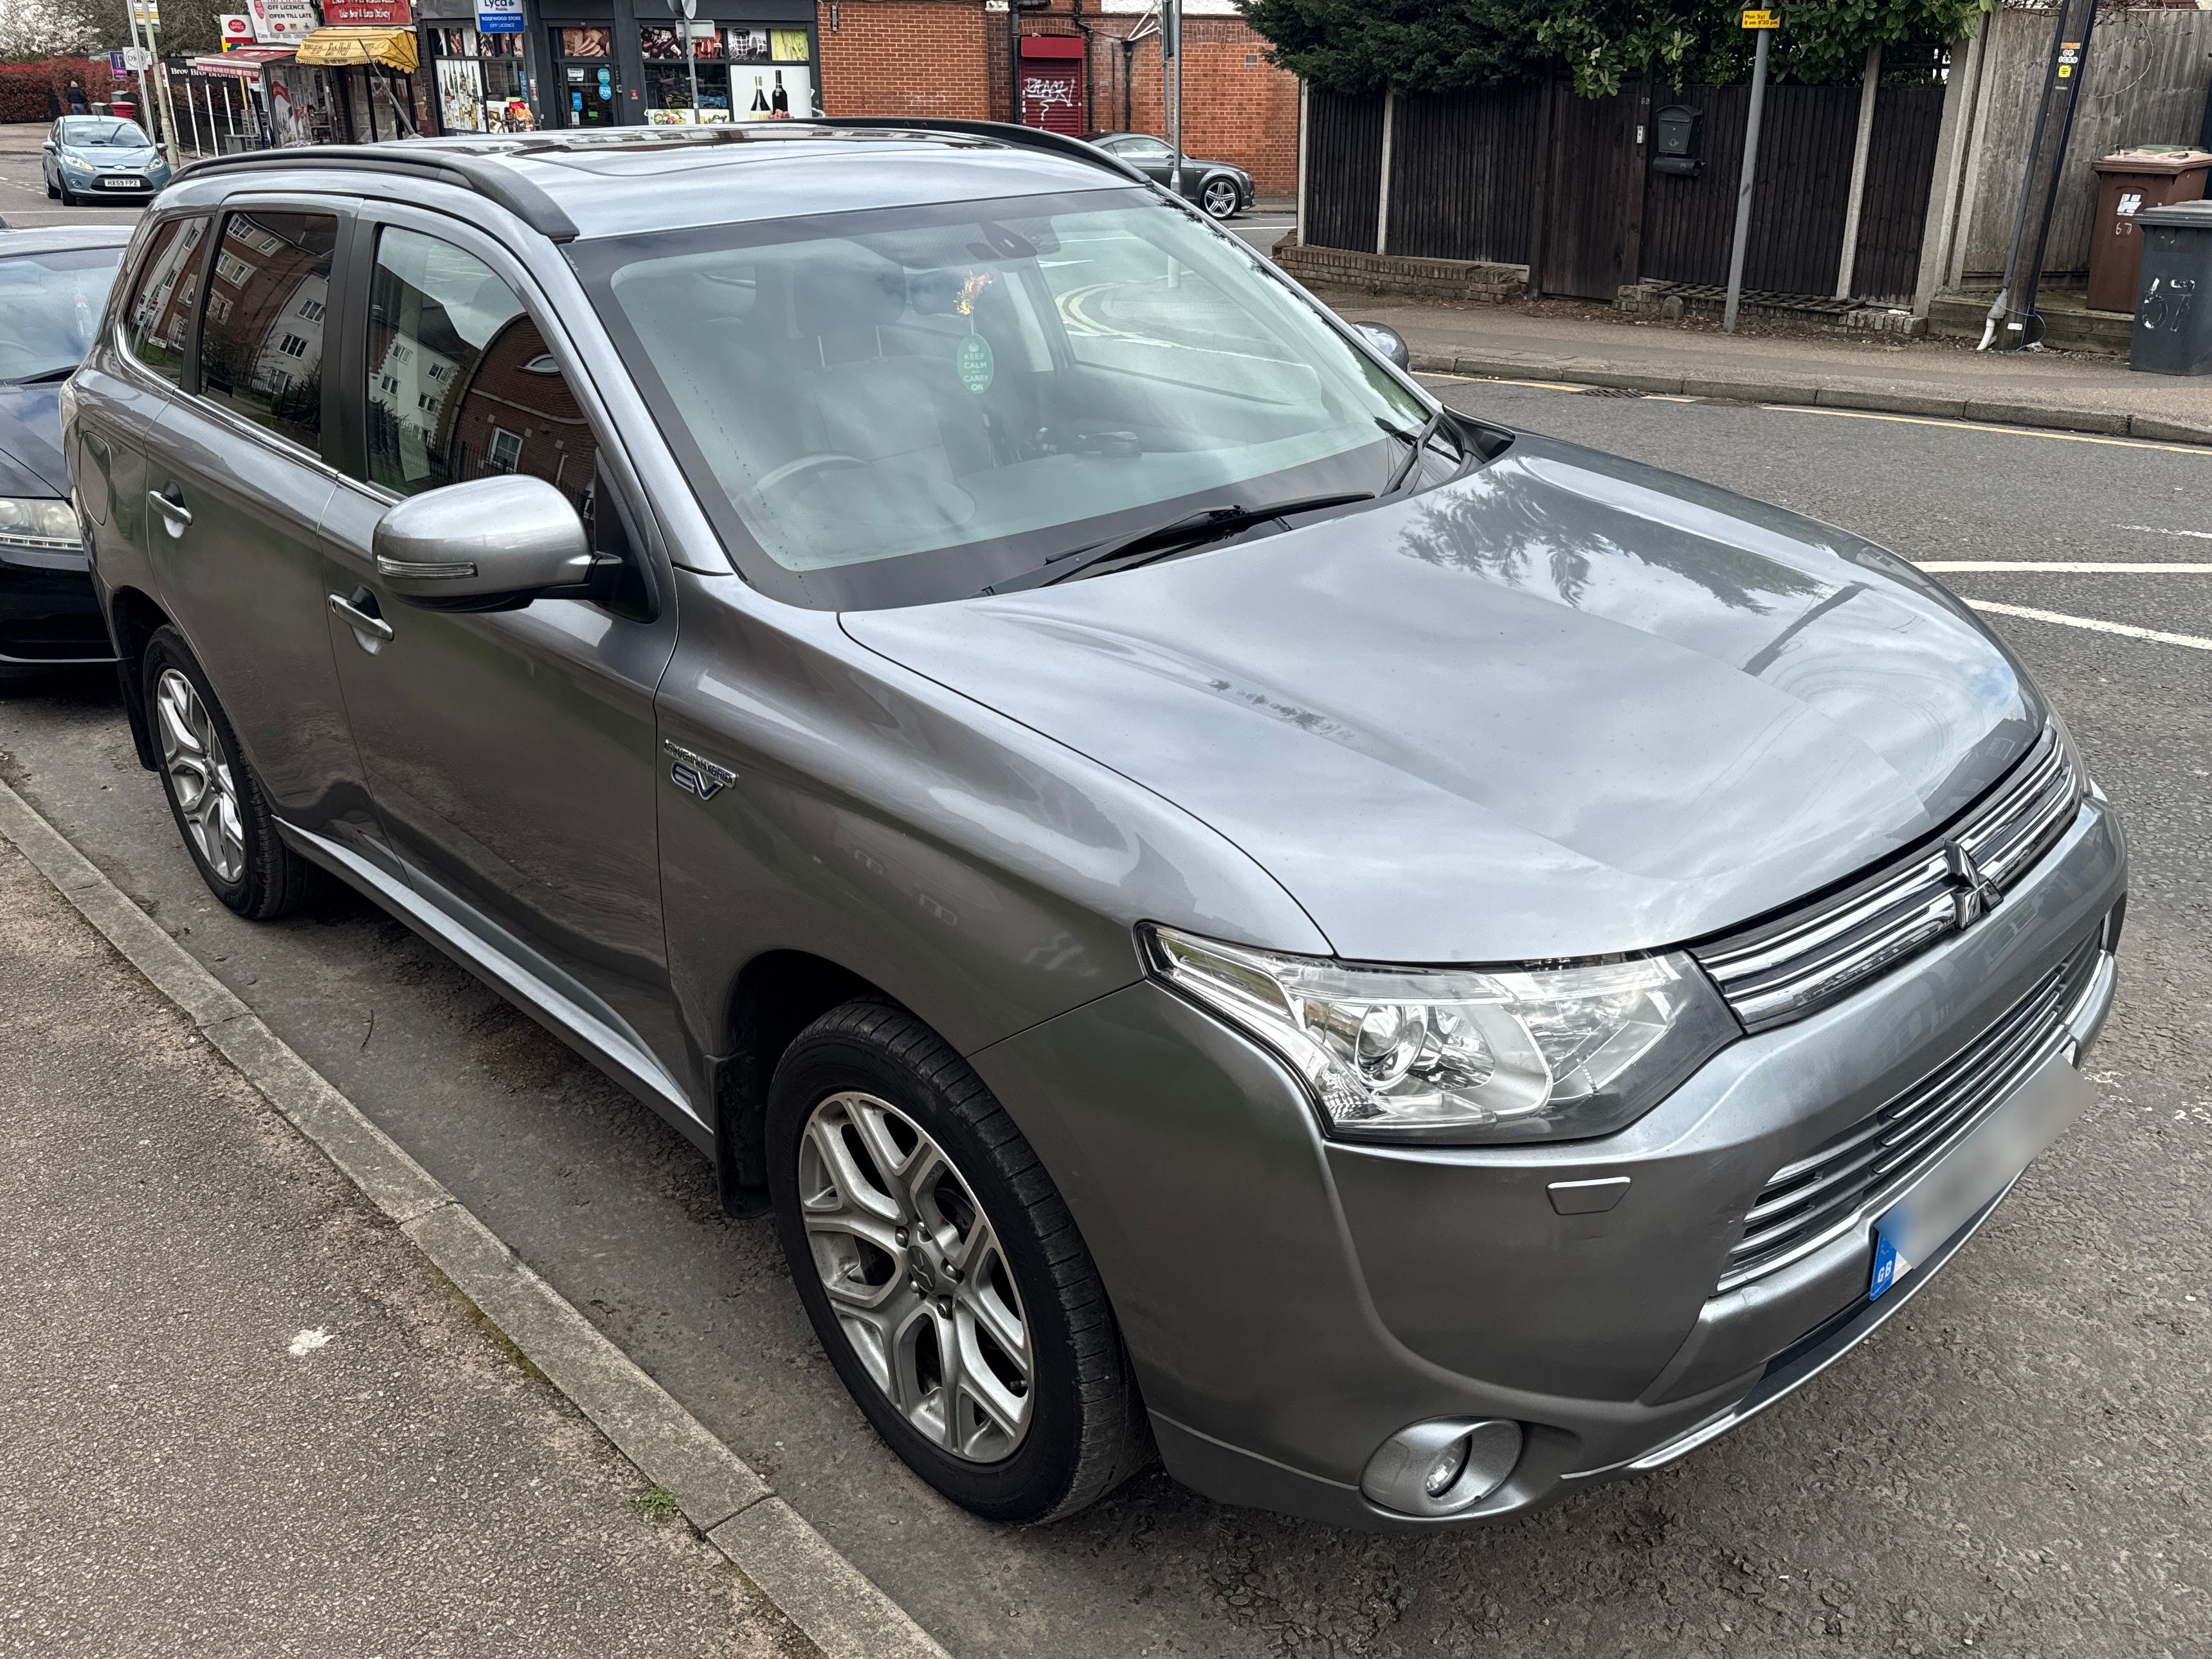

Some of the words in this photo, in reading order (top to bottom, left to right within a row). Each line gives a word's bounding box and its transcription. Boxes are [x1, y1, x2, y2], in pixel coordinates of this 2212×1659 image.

[2116, 222, 2132, 235] 67
[671, 761, 723, 800] EV
[1877, 1260, 1892, 1283] GB
